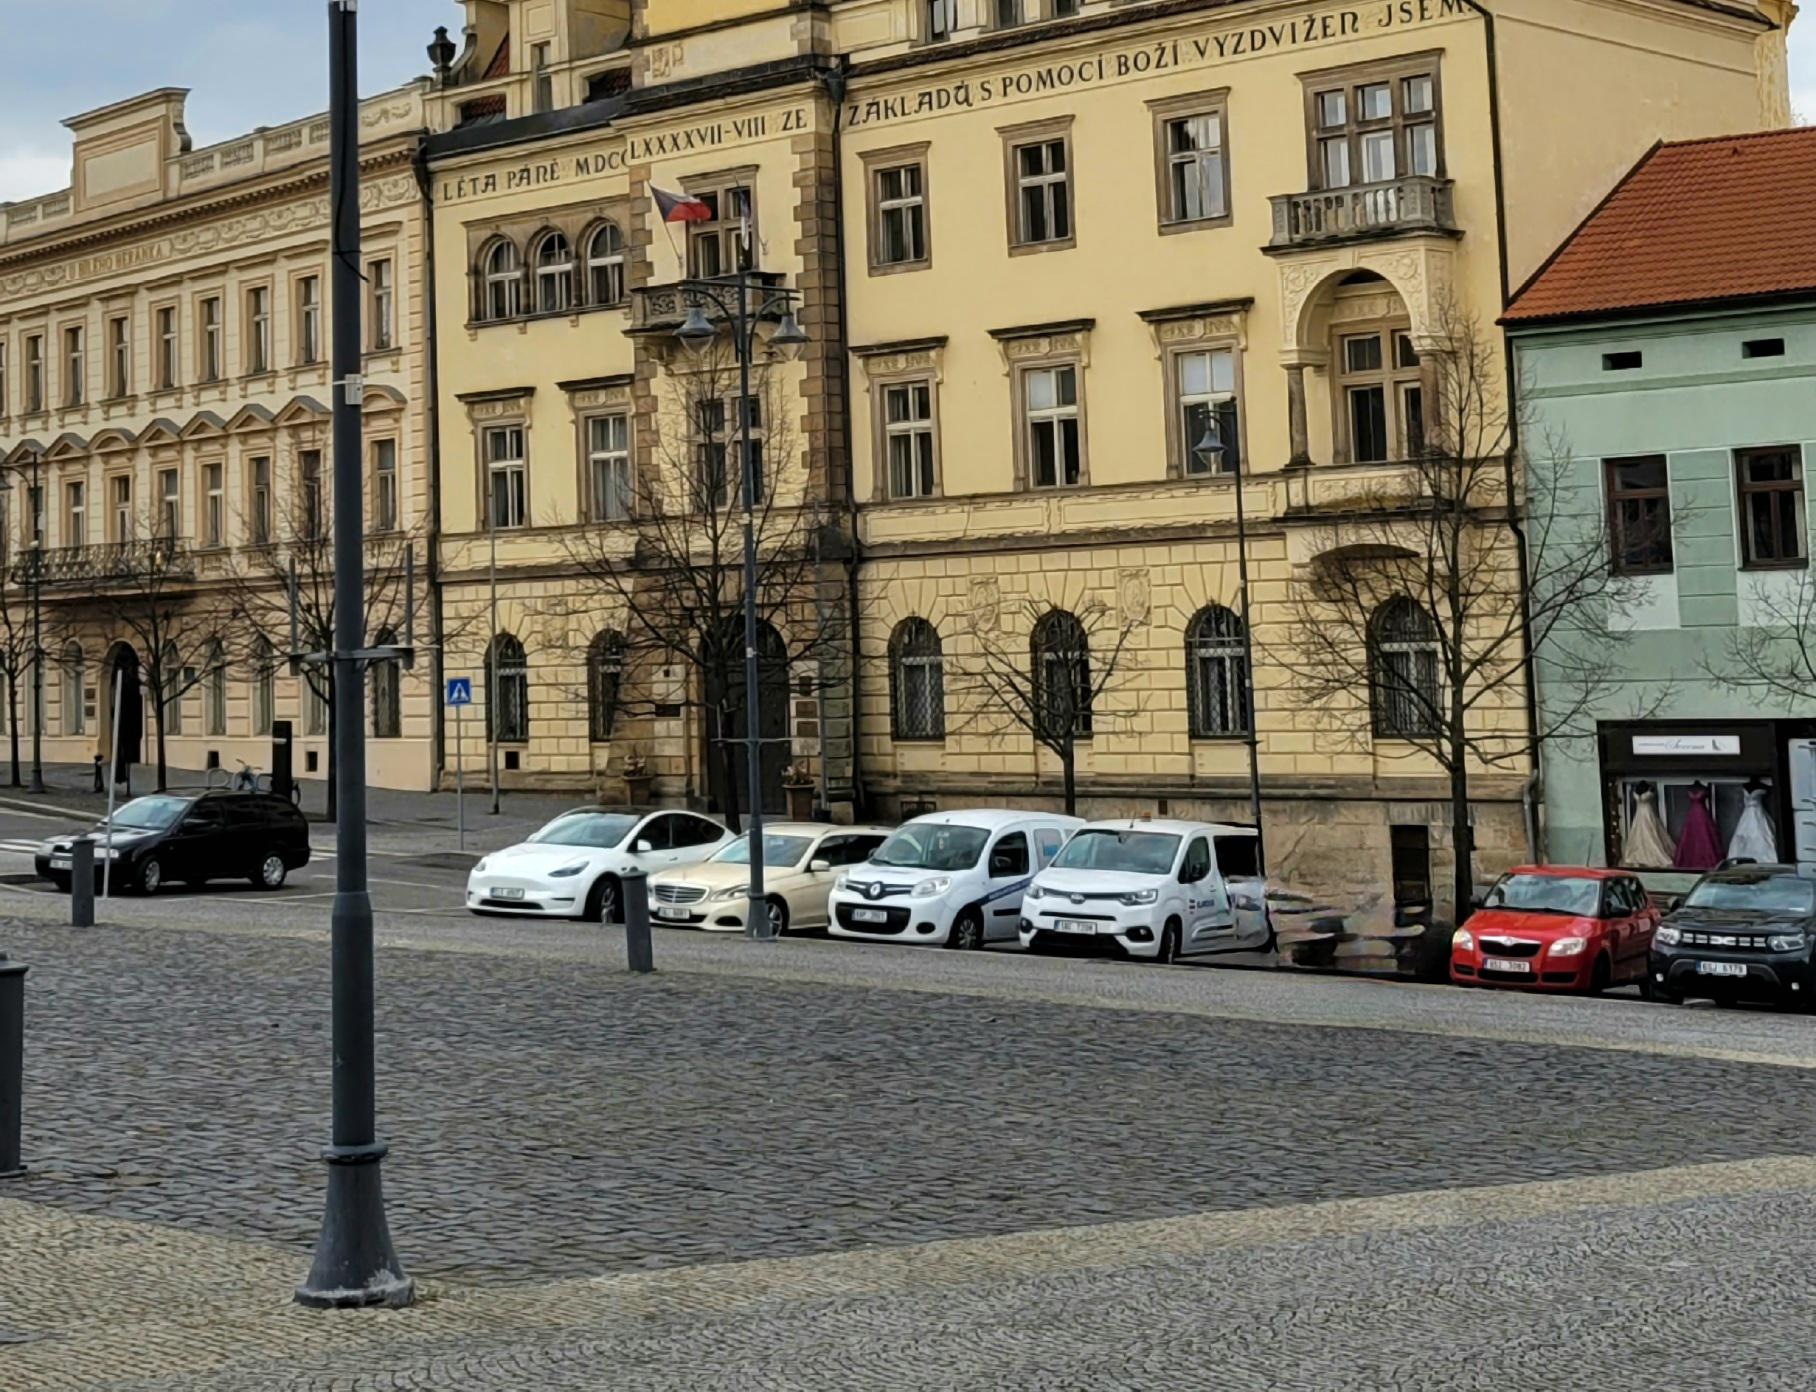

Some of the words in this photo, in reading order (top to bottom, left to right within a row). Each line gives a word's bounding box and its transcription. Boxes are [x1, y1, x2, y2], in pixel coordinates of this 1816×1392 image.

[980, 80, 993, 101] S
[1001, 53, 1104, 97] POMOCÍ
[1116, 39, 1179, 77] BOŽÍ
[1192, 11, 1360, 59] VYZDVIŽEN
[630, 115, 766, 160] LXXXXVII-VIII
[782, 108, 807, 131] ZE
[443, 172, 497, 201] LÉTA
